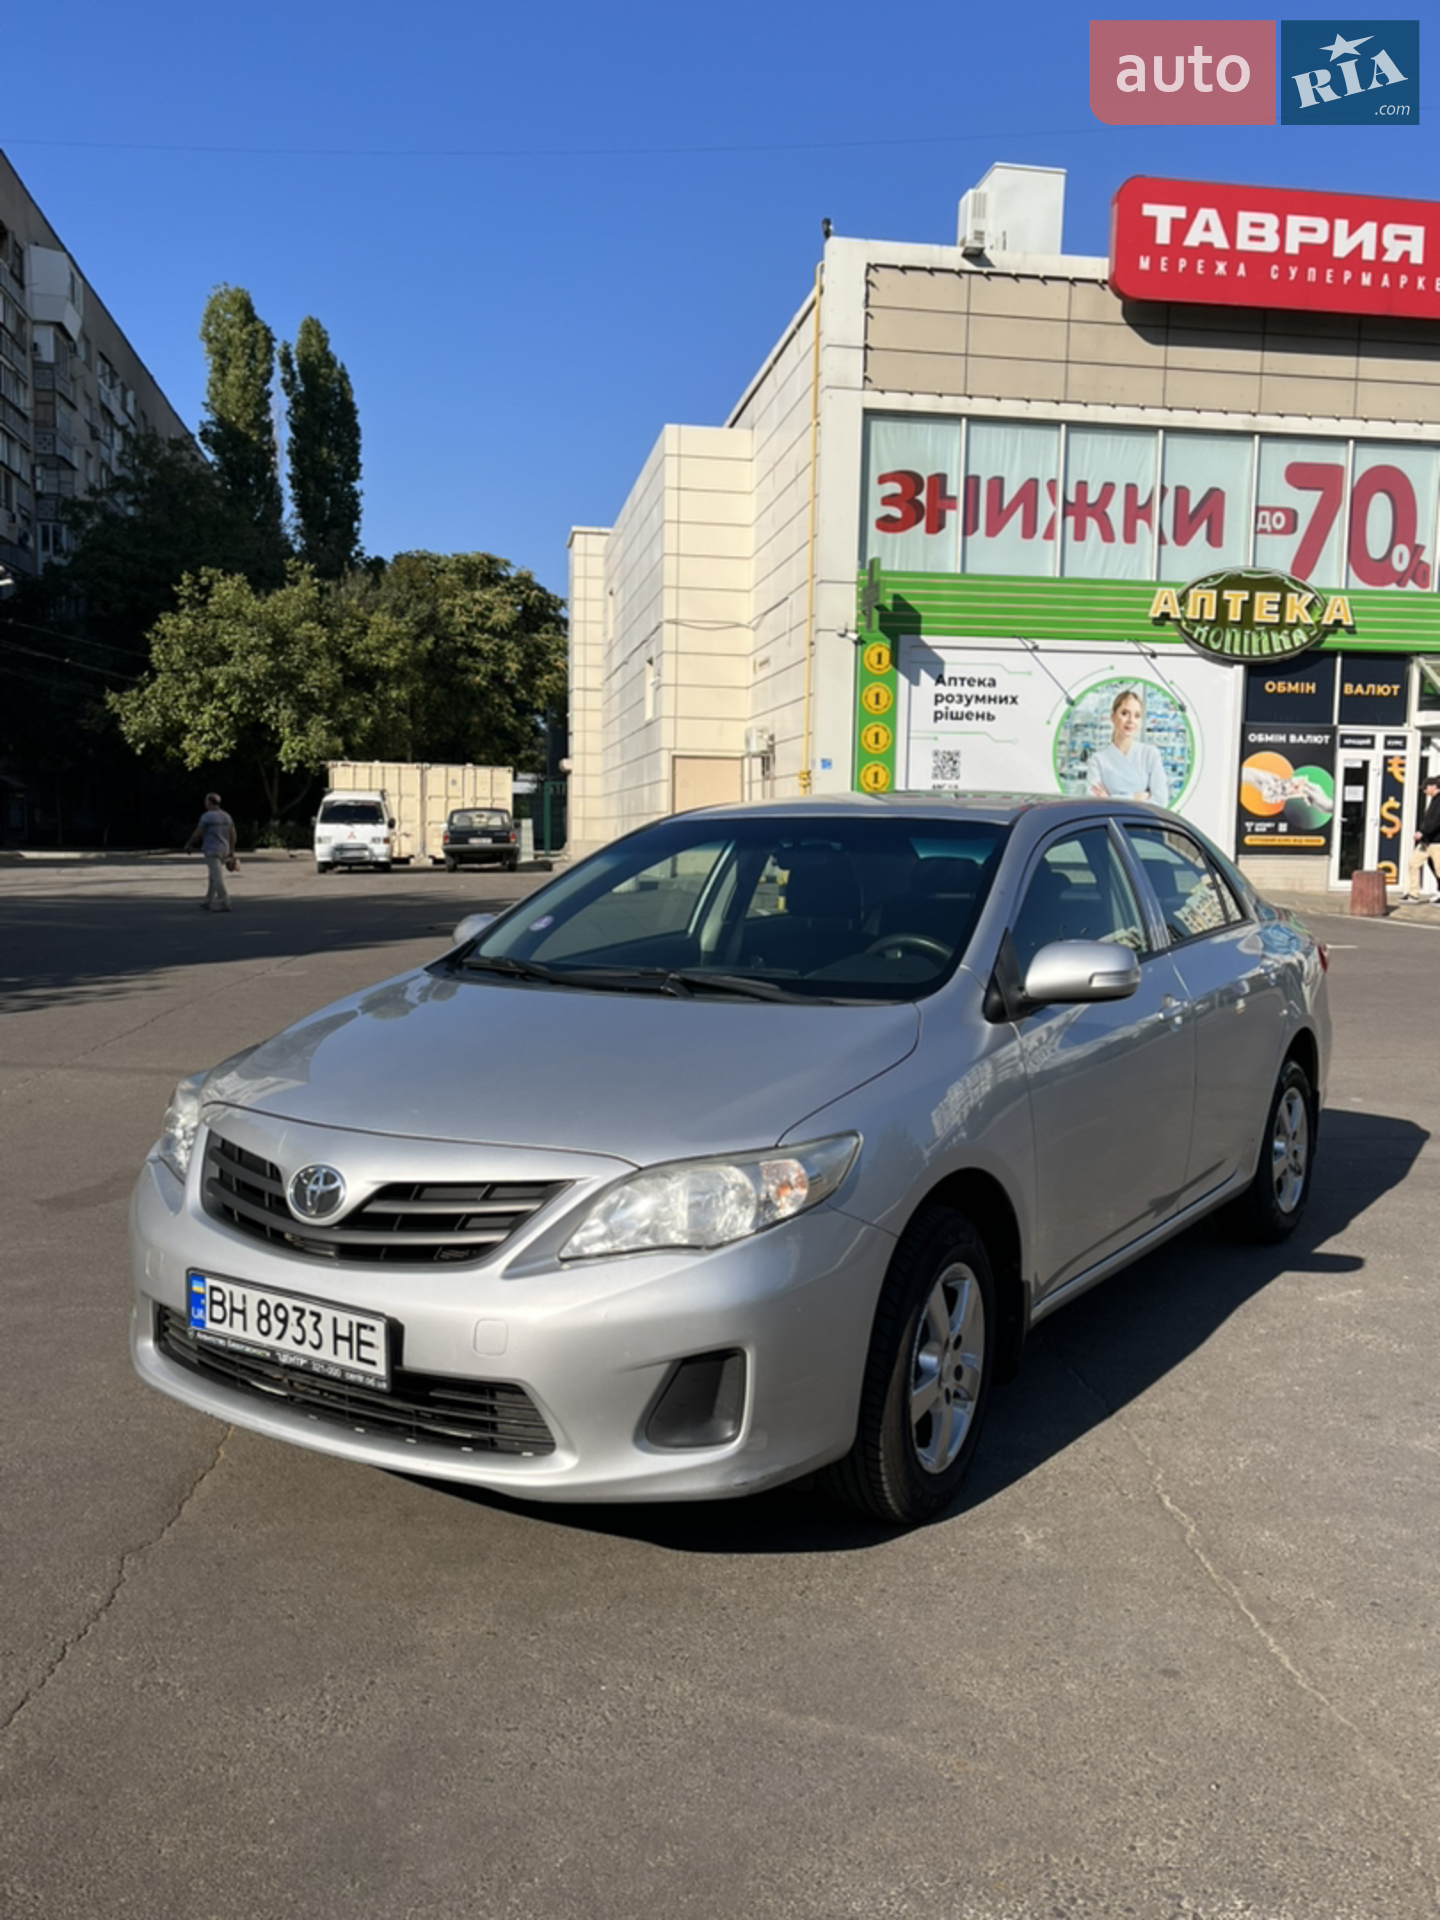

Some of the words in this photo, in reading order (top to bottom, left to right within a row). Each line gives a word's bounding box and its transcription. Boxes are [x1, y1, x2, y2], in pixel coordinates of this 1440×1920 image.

[1141, 203, 1426, 266] ТАВРИЯ
[1139, 255, 1247, 278] МЕРЕЖА
[874, 469, 1227, 549] ЗНИЖКИ
[1148, 587, 1355, 627] АПТЕКА
[935, 673, 997, 688] Аптека
[1264, 680, 1317, 694] ОБМІН
[1343, 683, 1401, 697] ВАЛЮТ
[933, 692, 1019, 707] розумних
[933, 706, 996, 723] рішень
[1248, 733, 1287, 744] ОБМІН
[1289, 734, 1331, 745] ВАЛЮТ
[209, 1285, 248, 1332] BH
[256, 1298, 324, 1350] 8933
[332, 1316, 377, 1367] HE
